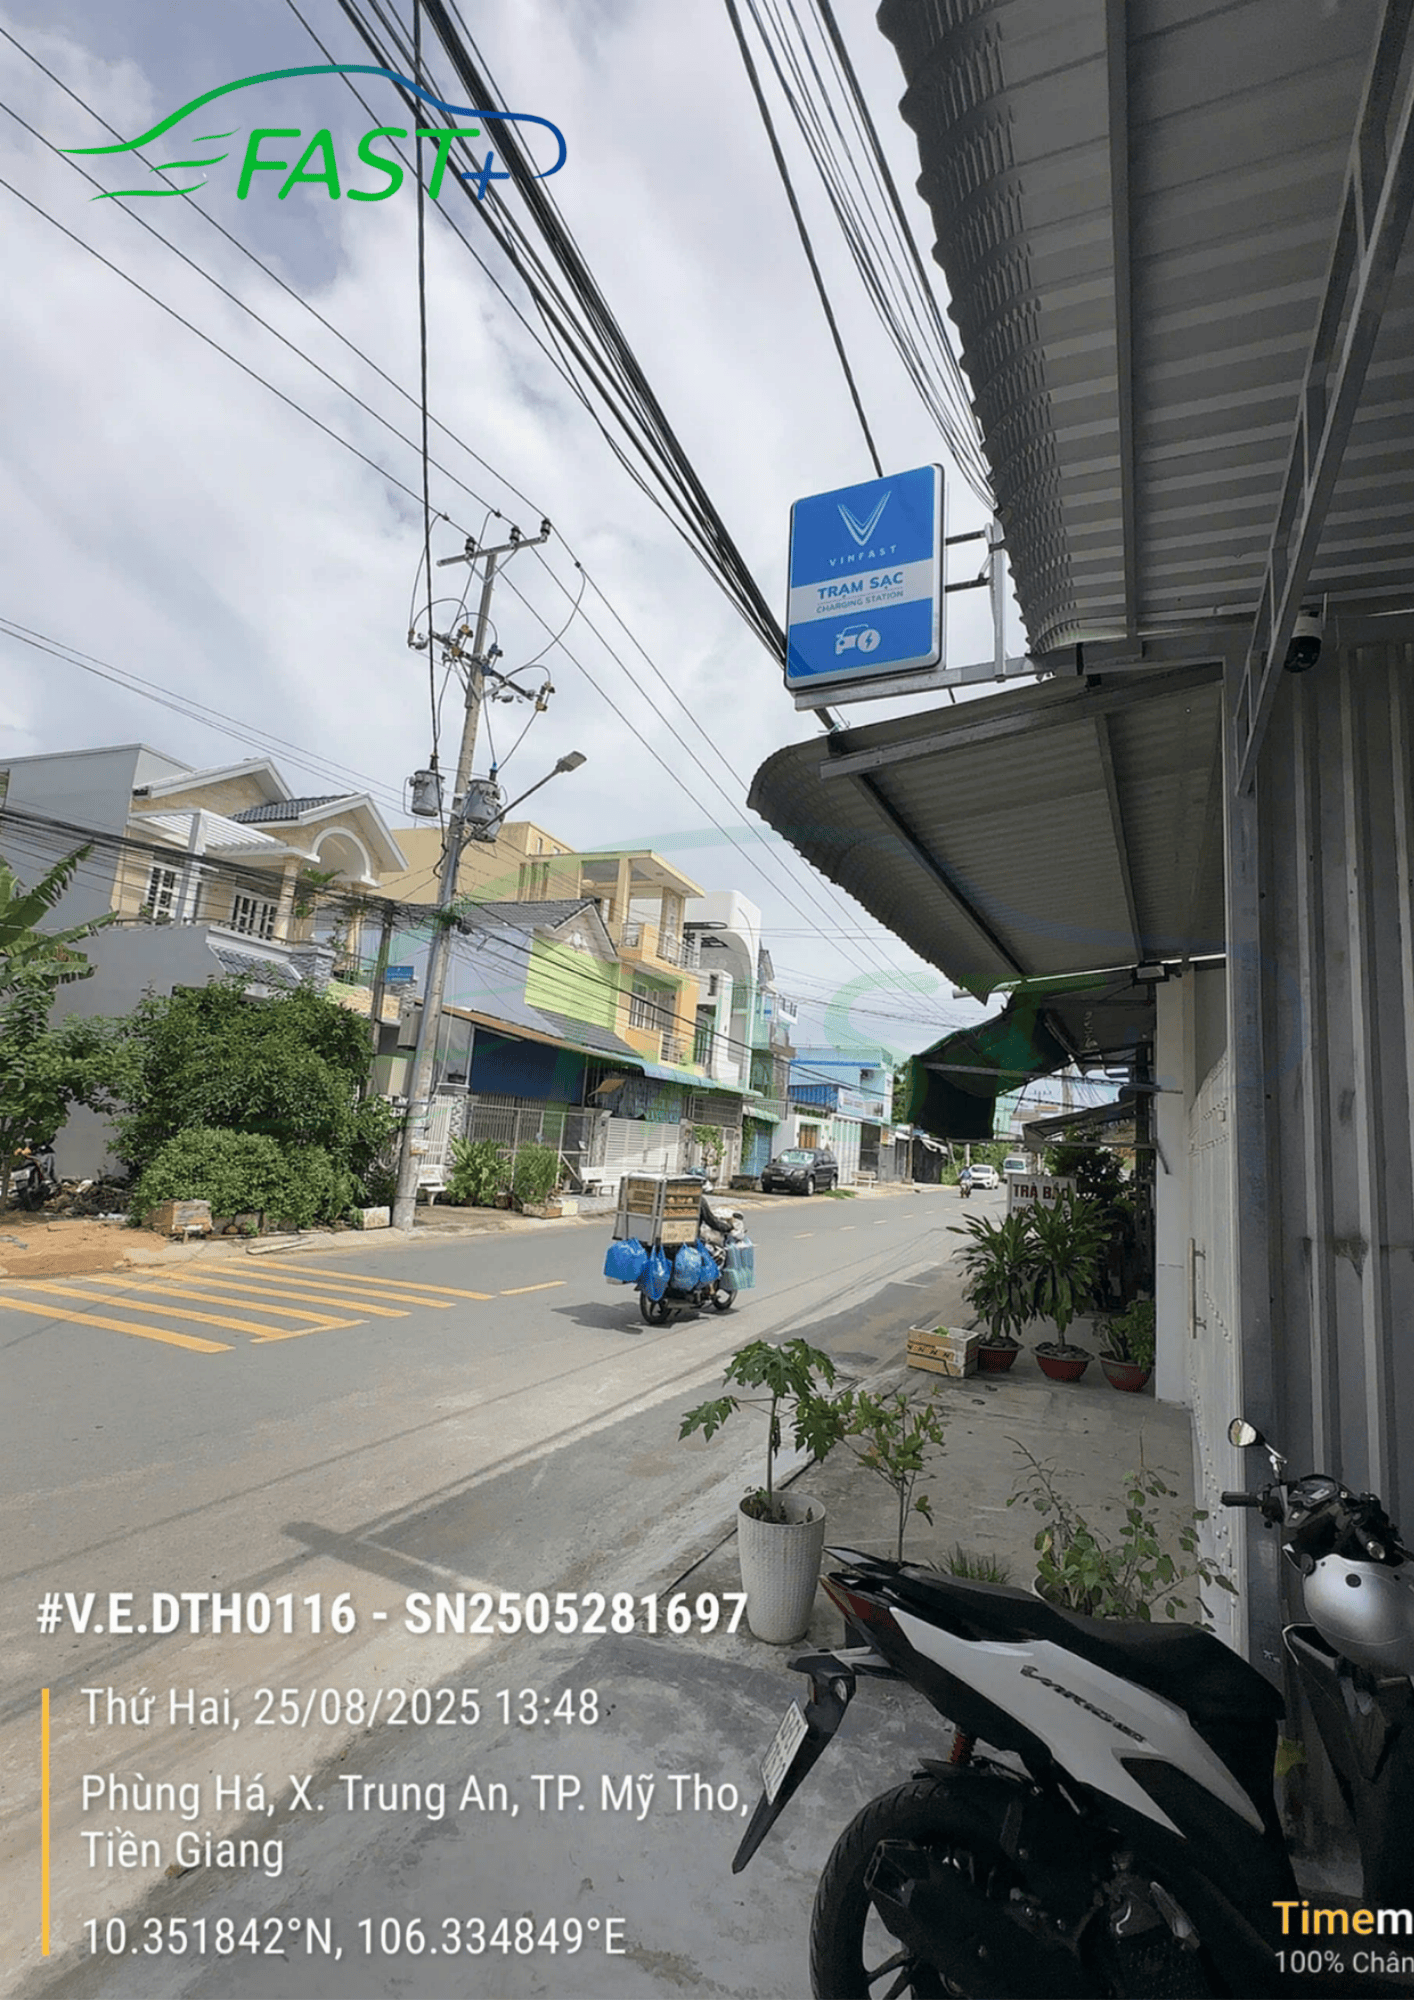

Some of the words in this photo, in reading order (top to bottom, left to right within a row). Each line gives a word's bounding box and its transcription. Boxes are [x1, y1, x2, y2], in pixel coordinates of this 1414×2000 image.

[829, 544, 896, 566] VINFAST
[817, 580, 863, 599] TRẠM
[869, 571, 903, 590] SẠC
[816, 599, 864, 613] CHARGING
[866, 591, 904, 604] STATION
